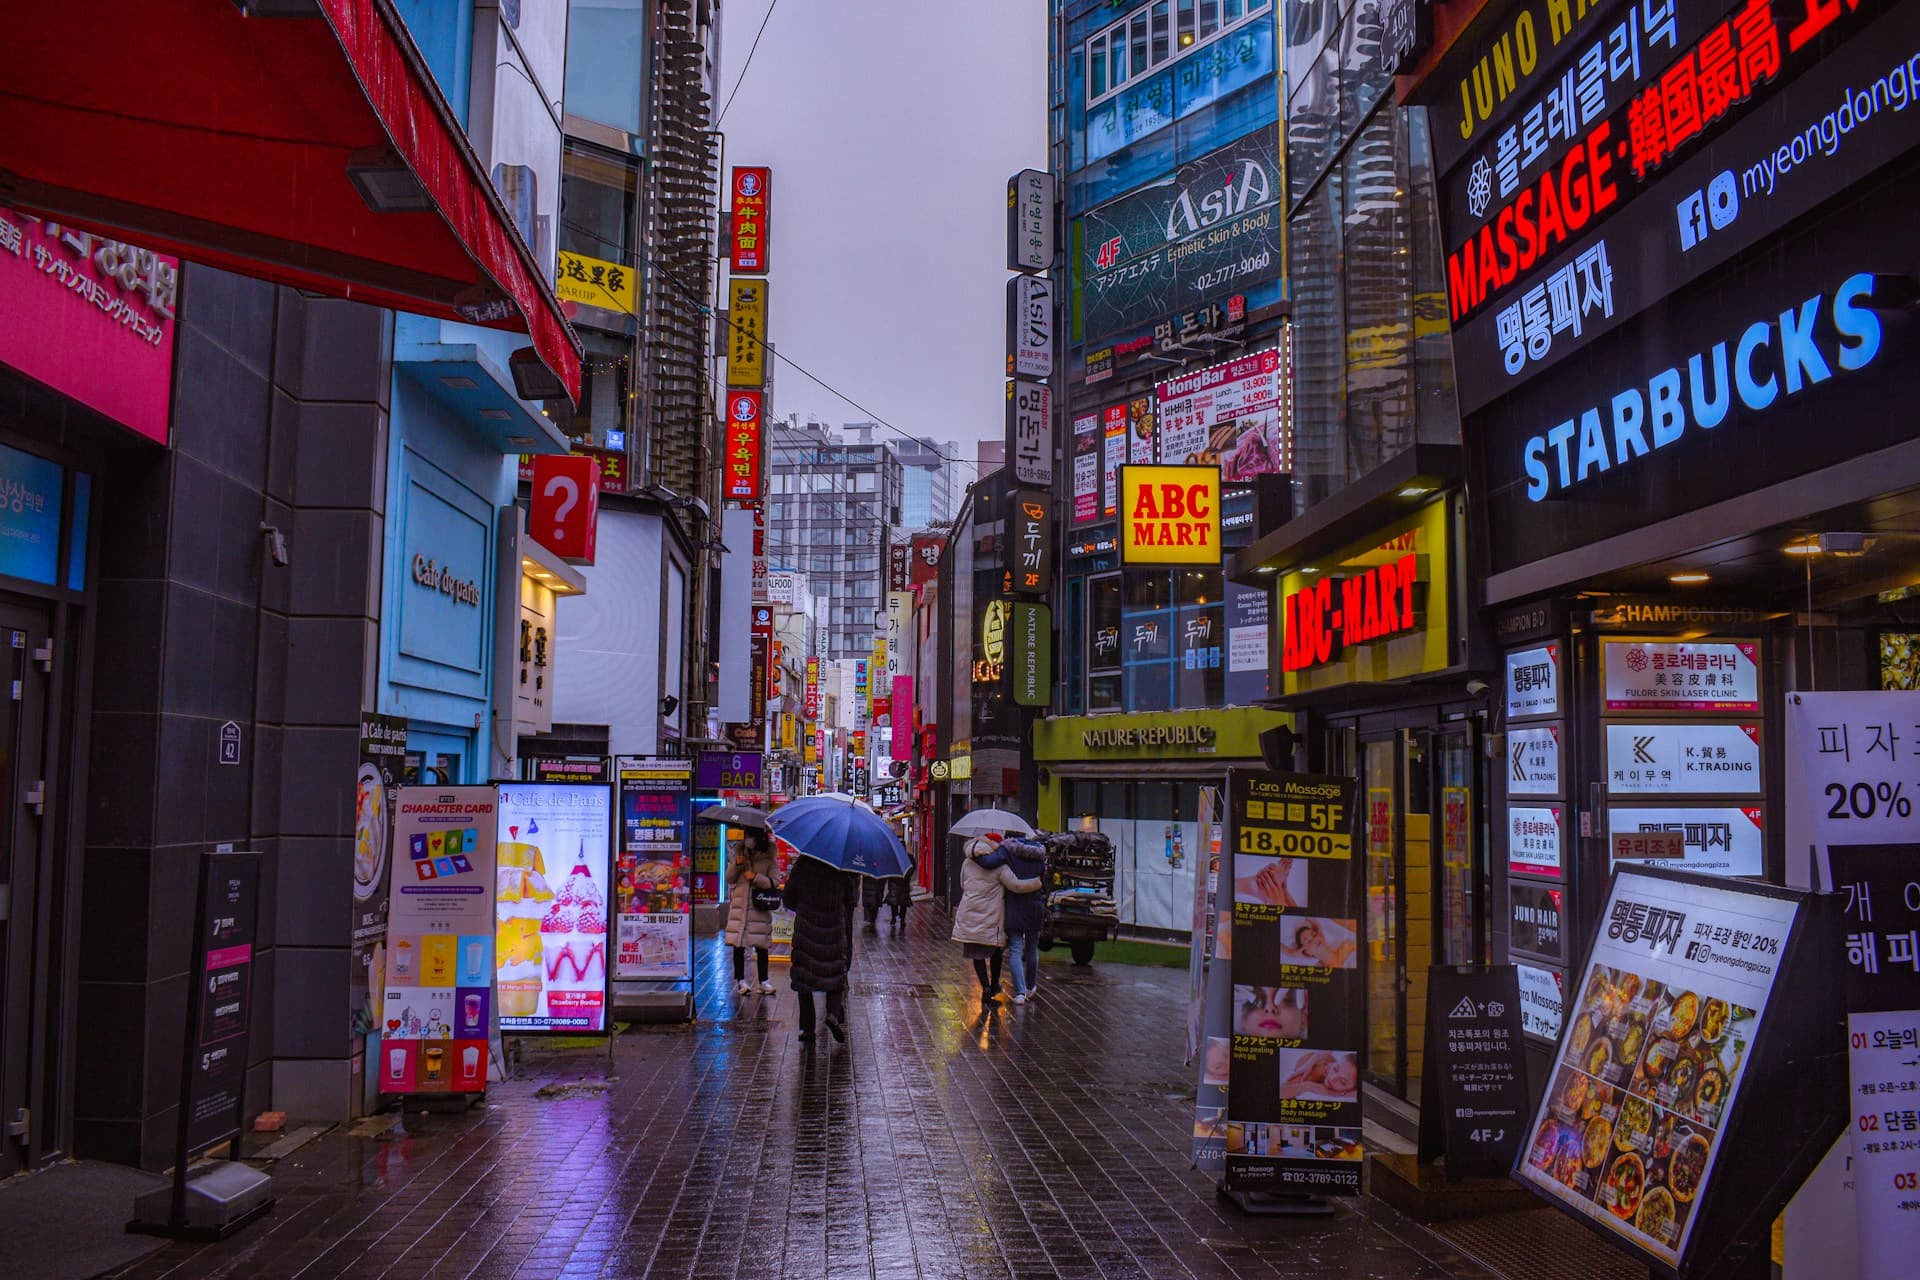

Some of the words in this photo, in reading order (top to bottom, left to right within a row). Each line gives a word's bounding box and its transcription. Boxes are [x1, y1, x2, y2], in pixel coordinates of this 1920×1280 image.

[1460, 19, 1539, 140] JUNO
[737, 205, 759, 250] 牛肉面
[1207, 228, 1231, 252] Skin
[1242, 210, 1271, 236] Body
[1448, 119, 1618, 323] MASSAGE
[1096, 236, 1121, 271] 4F
[1495, 240, 1614, 377] 명동피자
[1167, 367, 1227, 397] HongBar
[1524, 271, 1883, 503] STARBUCKS
[732, 431, 754, 477] 우육면
[1133, 483, 1210, 519] ABC
[1022, 521, 1043, 570] 두끼
[1133, 522, 1211, 546] MART
[413, 553, 441, 589] Cafe
[442, 566, 456, 595] de
[455, 575, 481, 608] paris
[1025, 573, 1039, 587] 2F
[1282, 552, 1417, 673] ABC-MART
[1027, 607, 1037, 649] NATURE
[1027, 650, 1037, 701] REPUBLIC
[1513, 662, 1551, 693] 명동피자
[1625, 689, 1658, 698] FULORE
[1659, 689, 1680, 698] SKIN
[1682, 689, 1709, 698] LASER
[1711, 689, 1738, 699] CLINIC
[1081, 727, 1135, 747] NATURE
[1139, 725, 1209, 745] REPUBLIC
[720, 771, 757, 788] BAR
[1613, 769, 1672, 781] 케이무역
[1686, 761, 1752, 772] K.TRADING
[548, 791, 565, 807] de
[569, 792, 604, 807] Paris
[1248, 779, 1280, 793] T.ara
[1285, 782, 1342, 799] Massage
[1824, 780, 1912, 820] 20%
[401, 803, 464, 814] CHARACTER
[464, 803, 493, 814] CARD
[1310, 802, 1344, 831] 5F
[1617, 838, 1682, 856] 유리조심
[1669, 861, 1730, 870] myeongdongpizza
[1514, 904, 1535, 924] JUNO
[1537, 908, 1558, 927] HAIR
[1608, 899, 1687, 956] 명동피자
[1693, 922, 1713, 940] 피자
[1712, 926, 1732, 945] 포장
[1751, 934, 1780, 955] 20%
[1709, 952, 1771, 975] myeongdongpizza
[1851, 1032, 1868, 1050] 01
[1872, 1027, 1919, 1050] 오늘의
[1469, 1128, 1492, 1142] 4F
[1858, 1114, 1879, 1133] 02
[1293, 1172, 1359, 1186] 02-3789-0122
[1893, 1173, 1918, 1191] 03
